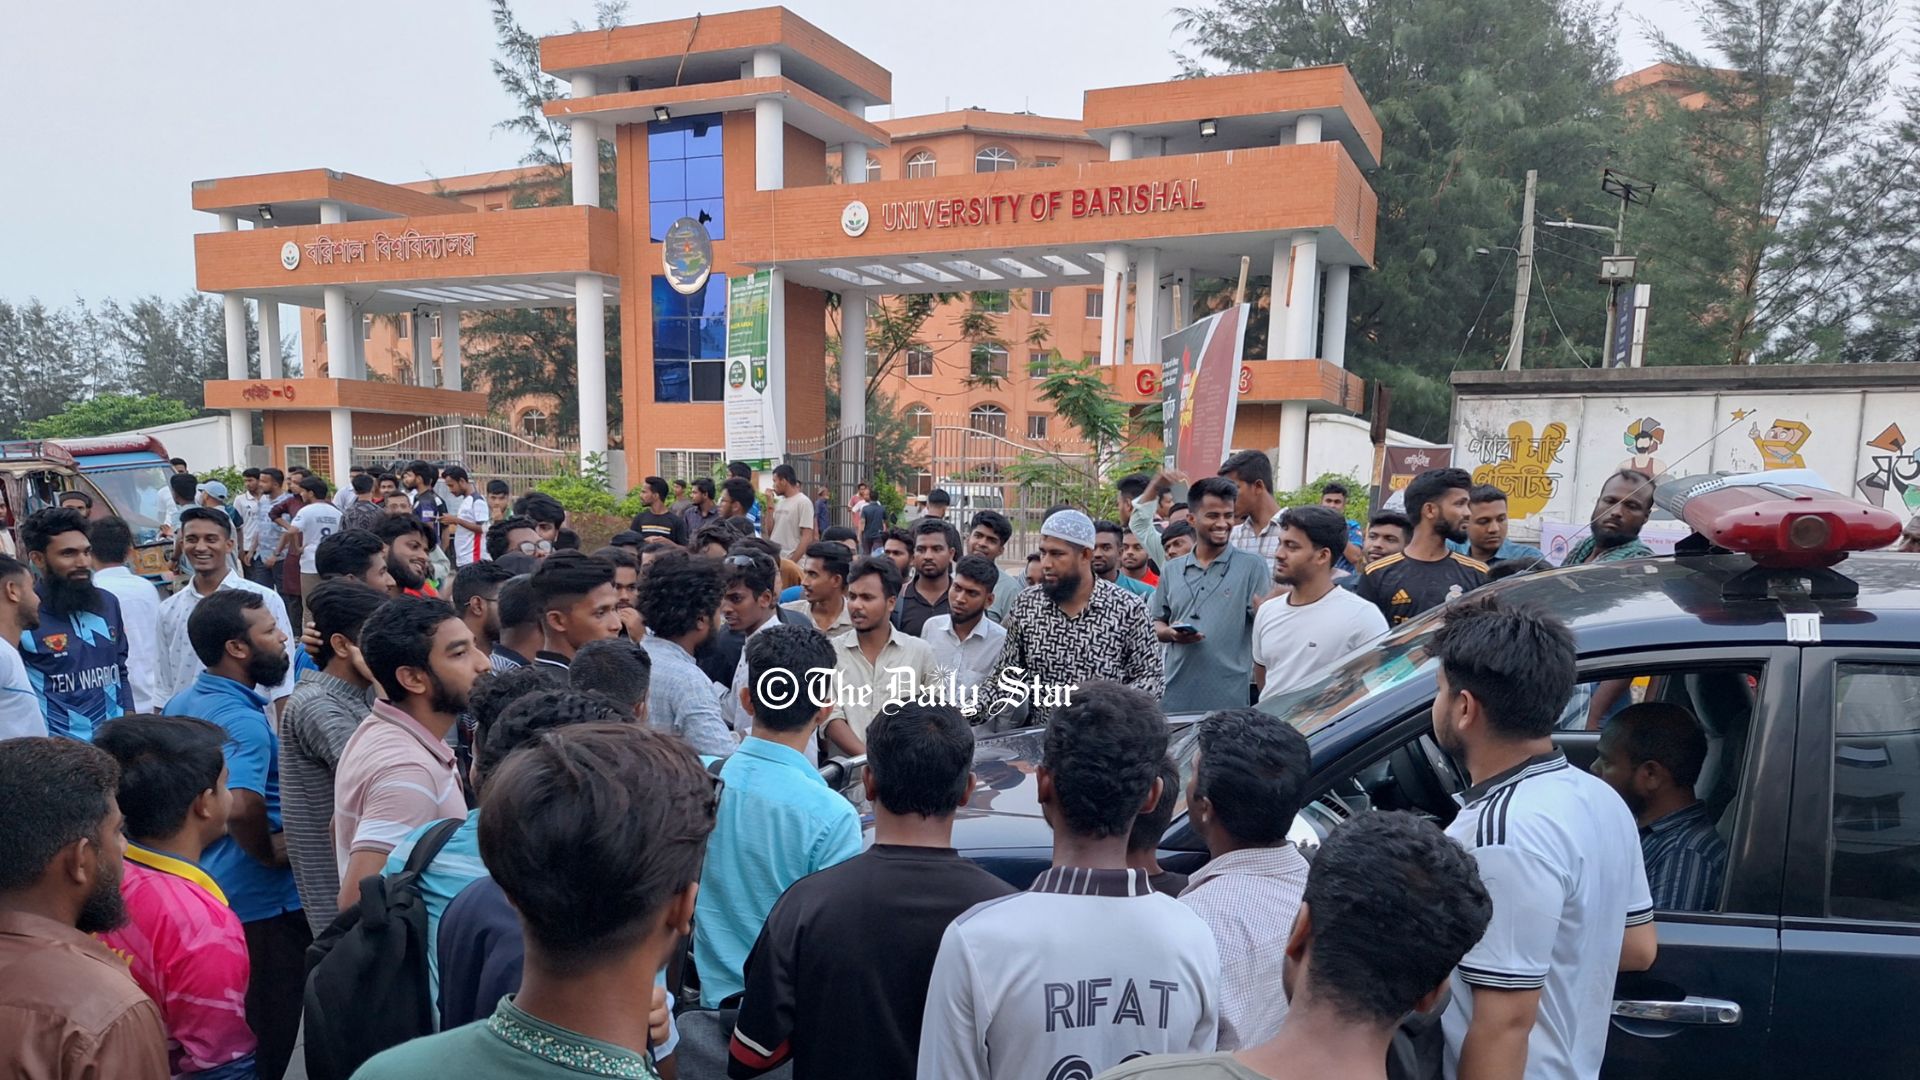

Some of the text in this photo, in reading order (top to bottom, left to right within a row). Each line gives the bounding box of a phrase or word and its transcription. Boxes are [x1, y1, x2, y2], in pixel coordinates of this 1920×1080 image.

[881, 178, 1206, 231] UNIVERSITY OF BARISHAL
[304, 228, 477, 265] বরিশাল বিশ্ববিদ্যালয়
[1527, 424, 1570, 464] নাই
[49, 673, 75, 693] TEN
[1043, 977, 1179, 1033] RIFAT
